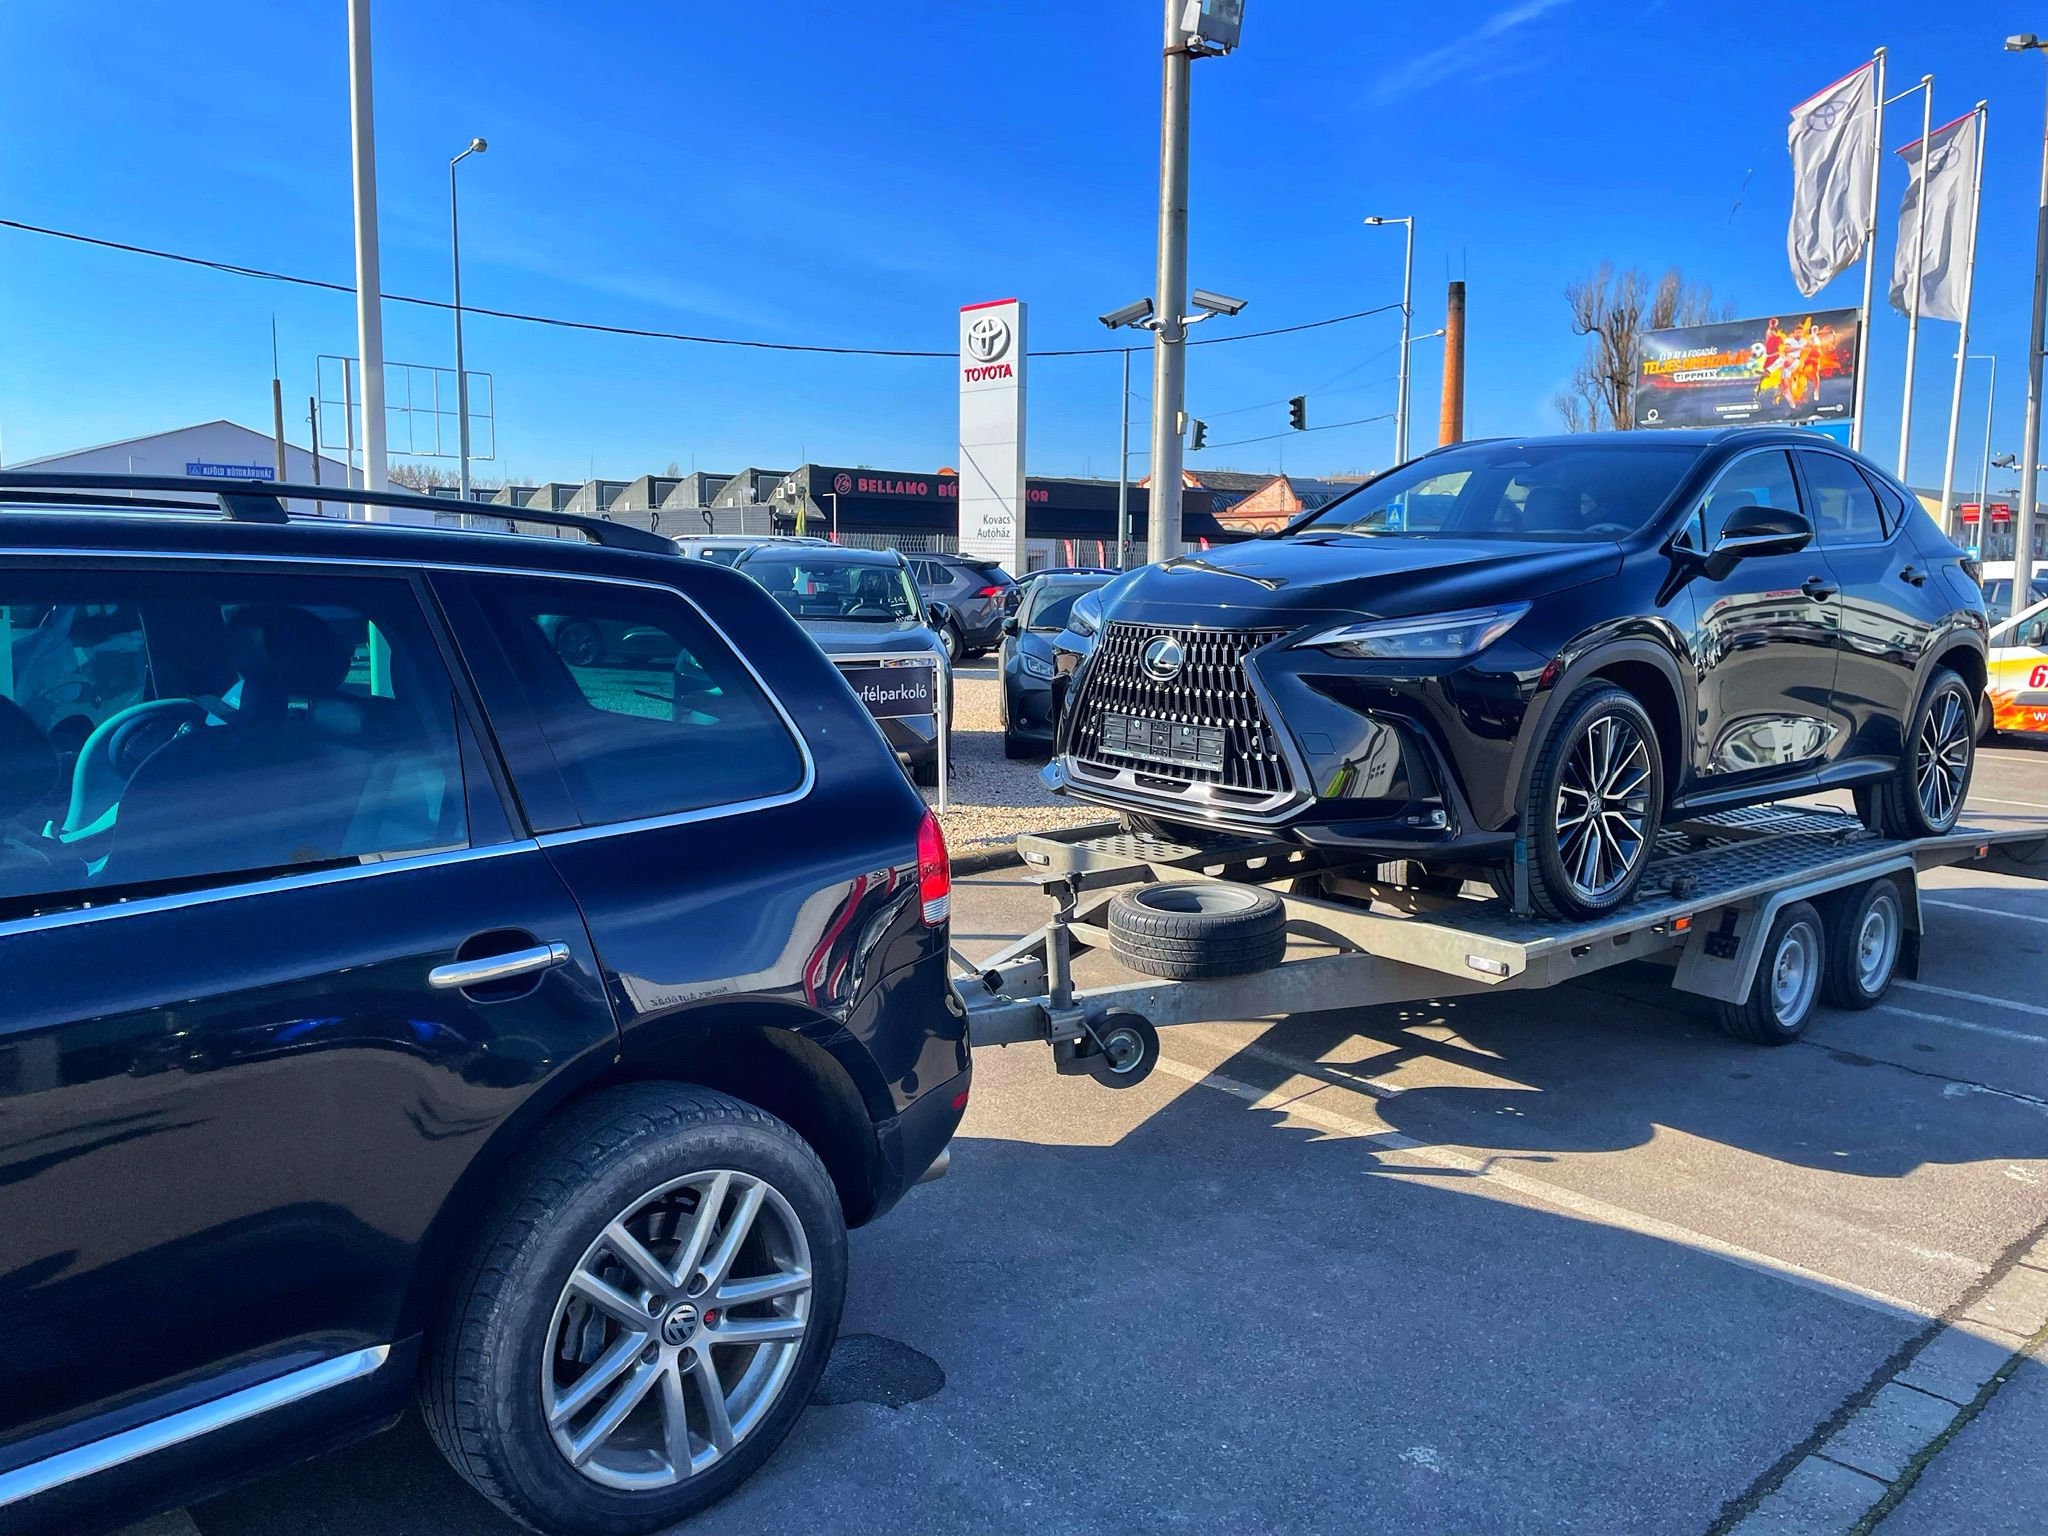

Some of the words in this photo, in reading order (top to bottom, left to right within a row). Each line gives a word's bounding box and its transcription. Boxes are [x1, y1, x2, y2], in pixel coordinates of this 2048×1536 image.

[964, 363, 1013, 382] TOYOTA
[1643, 359, 1682, 375] TELJES
[203, 466, 225, 476] ALFÖLD
[858, 478, 928, 496] BELLAMO
[938, 482, 959, 498] BÚ
[1026, 489, 1049, 503] OR
[983, 514, 1011, 525] Kovacs
[977, 527, 1010, 538] Autóház
[2029, 664, 2048, 688] 6
